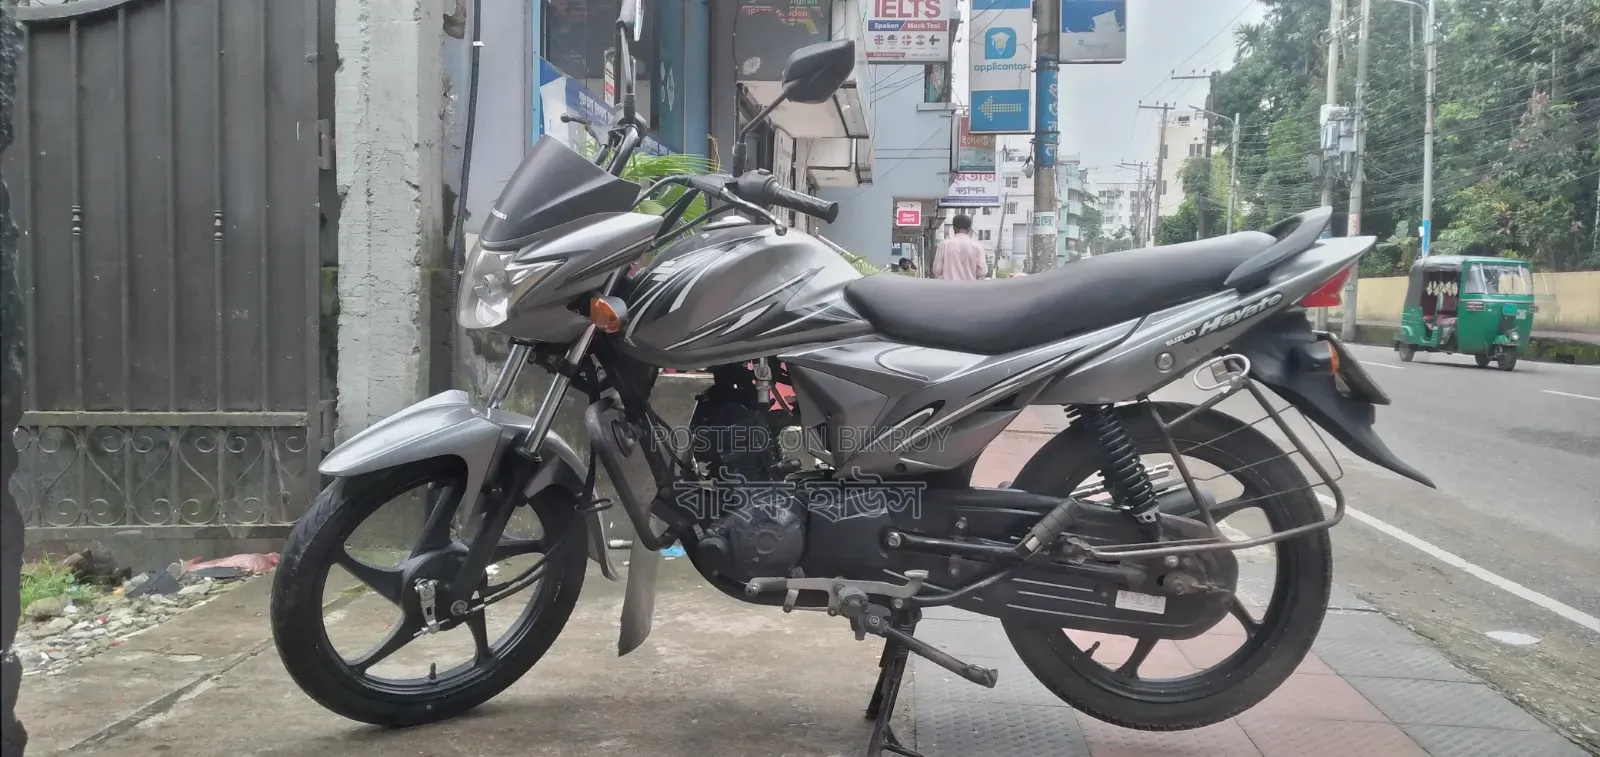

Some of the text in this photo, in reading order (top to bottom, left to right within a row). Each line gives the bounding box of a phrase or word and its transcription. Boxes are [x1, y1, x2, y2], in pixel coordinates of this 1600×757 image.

[874, 0, 941, 18] IELTS
[973, 62, 1027, 73] applicantor
[1165, 293, 1283, 347] SUZUKI Hayate
